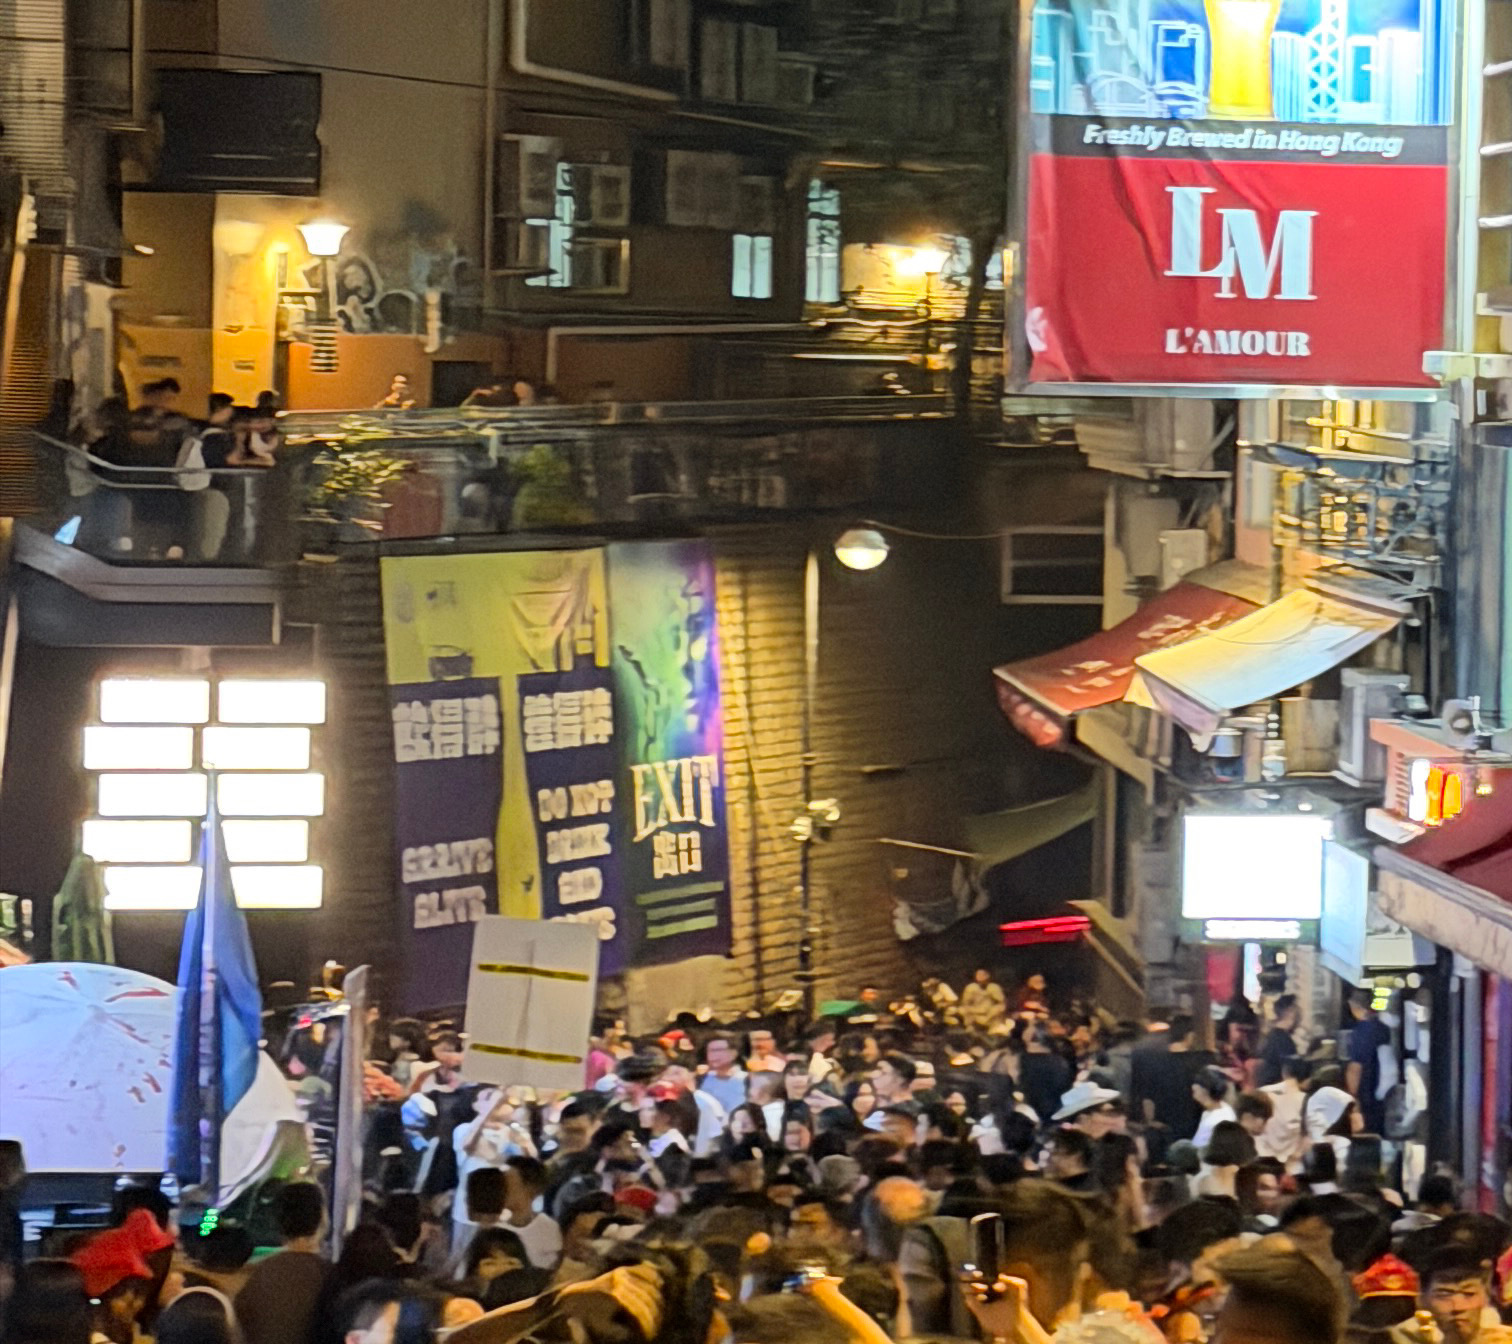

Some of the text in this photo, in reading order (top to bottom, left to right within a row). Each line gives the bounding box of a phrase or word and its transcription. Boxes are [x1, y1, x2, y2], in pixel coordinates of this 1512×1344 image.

[1083, 124, 1404, 157] Freshly Brewed in Hong Kong
[1165, 327, 1310, 356] L'AMOUR
[630, 756, 720, 843] EXIT
